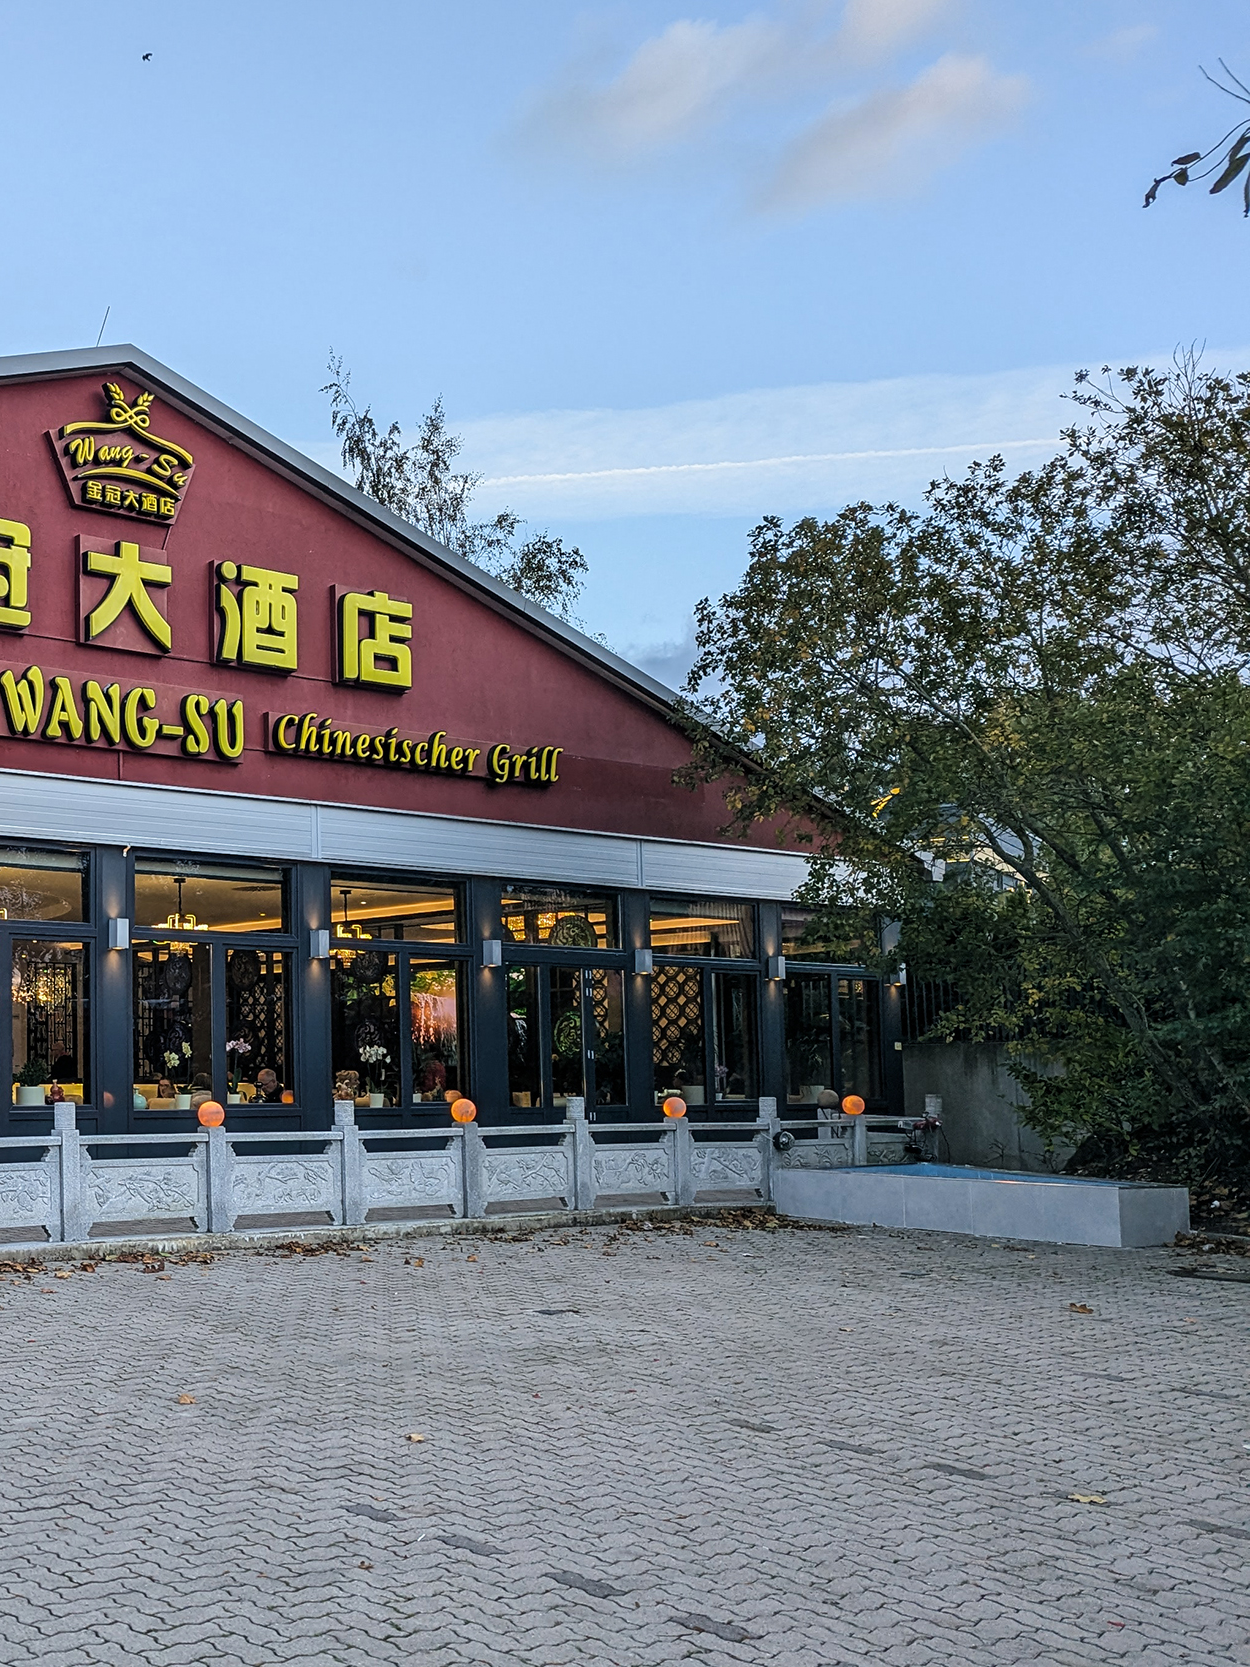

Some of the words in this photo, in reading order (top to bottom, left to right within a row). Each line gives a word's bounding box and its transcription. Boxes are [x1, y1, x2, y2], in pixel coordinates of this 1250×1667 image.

[84, 479, 176, 518] 金冠大酒店
[277, 711, 482, 774] Chinesischer
[490, 743, 563, 785] Grill
